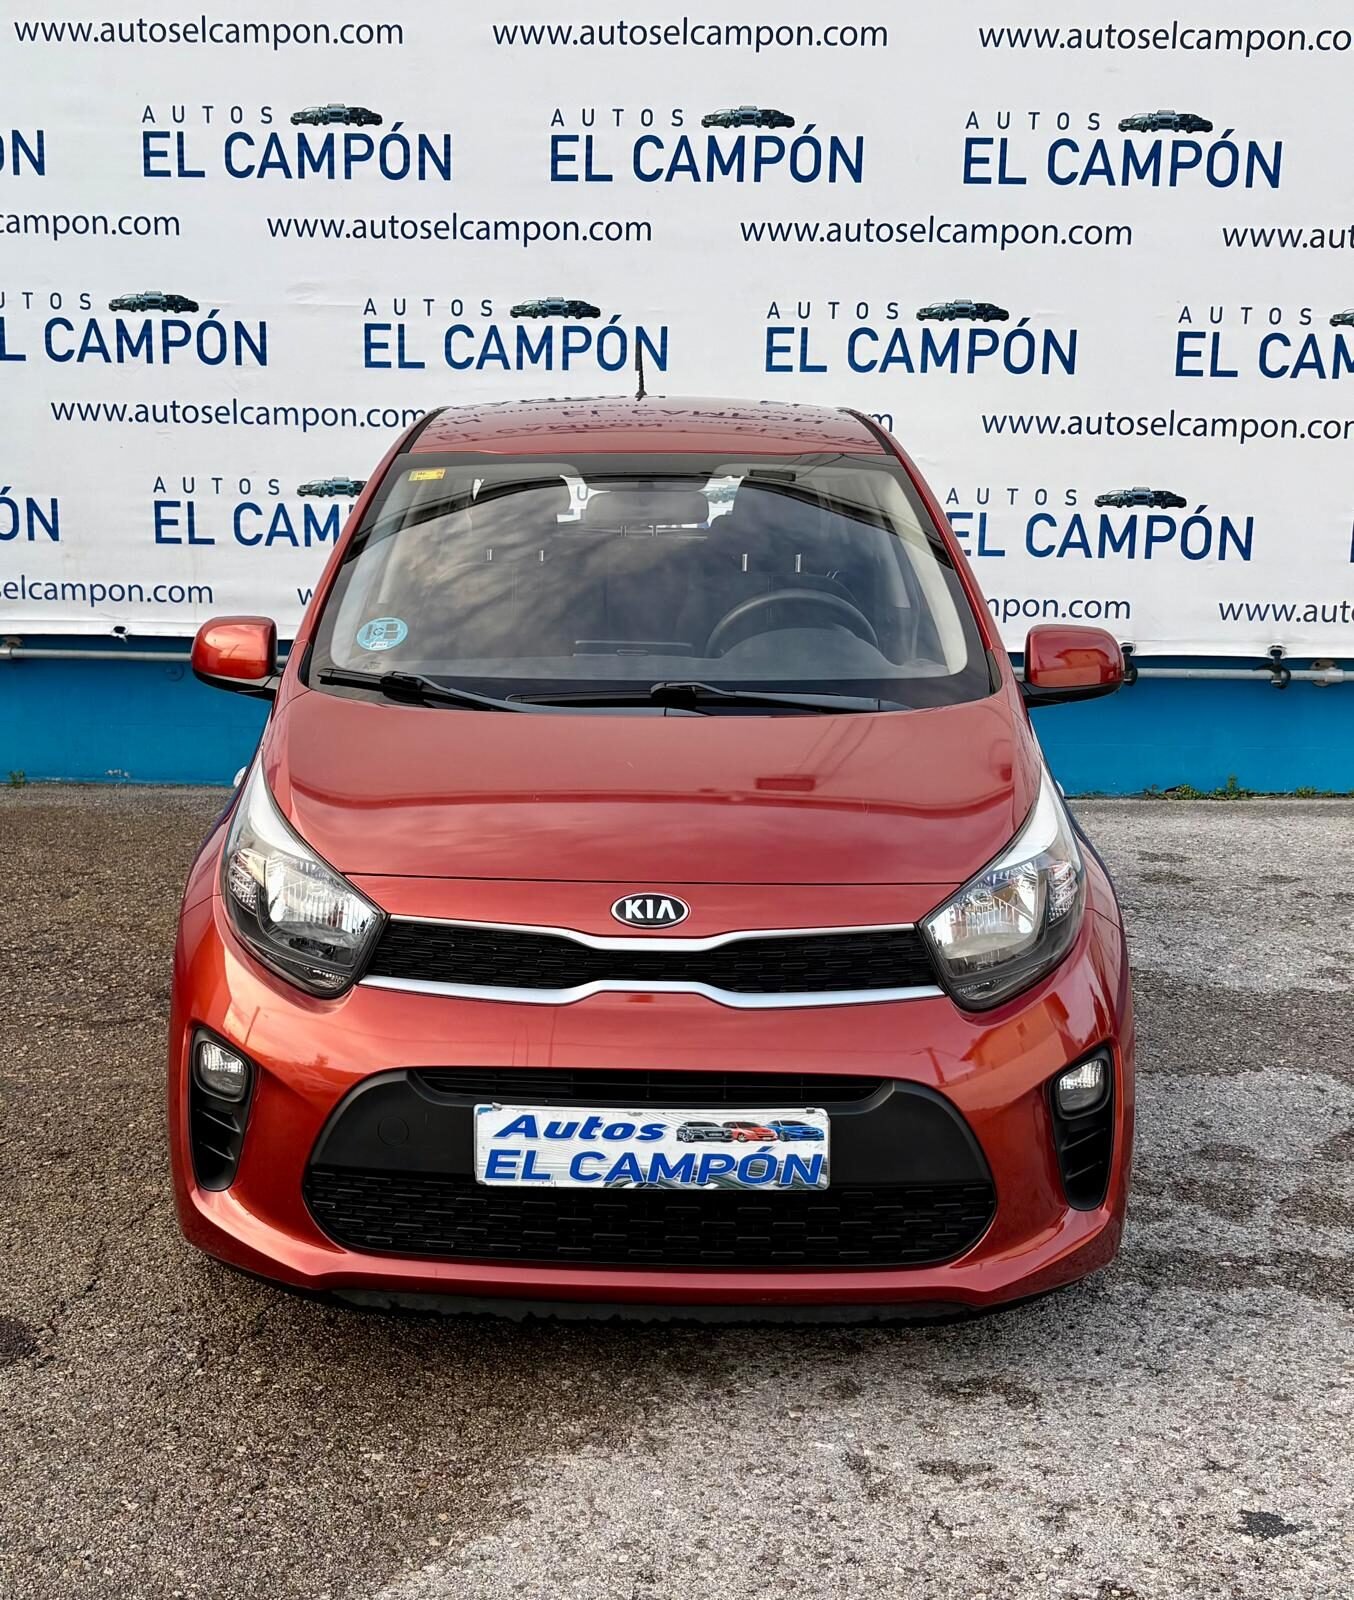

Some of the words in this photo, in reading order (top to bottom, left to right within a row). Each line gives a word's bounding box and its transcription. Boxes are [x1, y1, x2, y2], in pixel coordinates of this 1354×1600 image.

[14, 15, 402, 50] www.autoselcampon.com
[493, 17, 887, 53] www.autoselcampon.com
[979, 21, 1351, 57] www.autoselcampon.co
[142, 105, 272, 124] AUTOS
[551, 108, 683, 127] AUTOS
[966, 111, 1100, 130] AUTOS
[143, 131, 205, 178] EL
[225, 122, 451, 181] CAMPÓN
[551, 135, 613, 182] EL
[633, 124, 863, 183] CAMPÓN
[963, 137, 1027, 184] EL
[1048, 129, 1282, 188] CAMPÓN
[267, 212, 651, 247] www.autoselcampon.com
[740, 215, 1131, 250] www.autoselcampon.com
[364, 298, 492, 317] AUTOS
[767, 302, 898, 319] AUTOS
[1178, 306, 1311, 325] AUTOS
[45, 310, 267, 366] CAMPÓN
[364, 323, 425, 369] EL
[445, 314, 668, 372] CAMPÓN
[766, 327, 827, 372] EL
[848, 317, 1077, 375] CAMPÓN
[1175, 331, 1238, 377] EL
[51, 399, 425, 431] www.autoselcampon.com
[153, 476, 279, 495] AUTOS
[946, 488, 1076, 506] AUTOS
[154, 500, 215, 545] EL
[234, 502, 340, 547] CAM
[946, 512, 1005, 556] EL
[1026, 505, 1253, 561] CAMPÓN
[0, 575, 213, 607] elcampon.com
[1219, 601, 1354, 623] www.aut
[625, 899, 677, 920] KIA
[493, 1115, 667, 1141] Autos
[485, 1149, 552, 1181] EL
[569, 1146, 825, 1185] CAMPÓN
